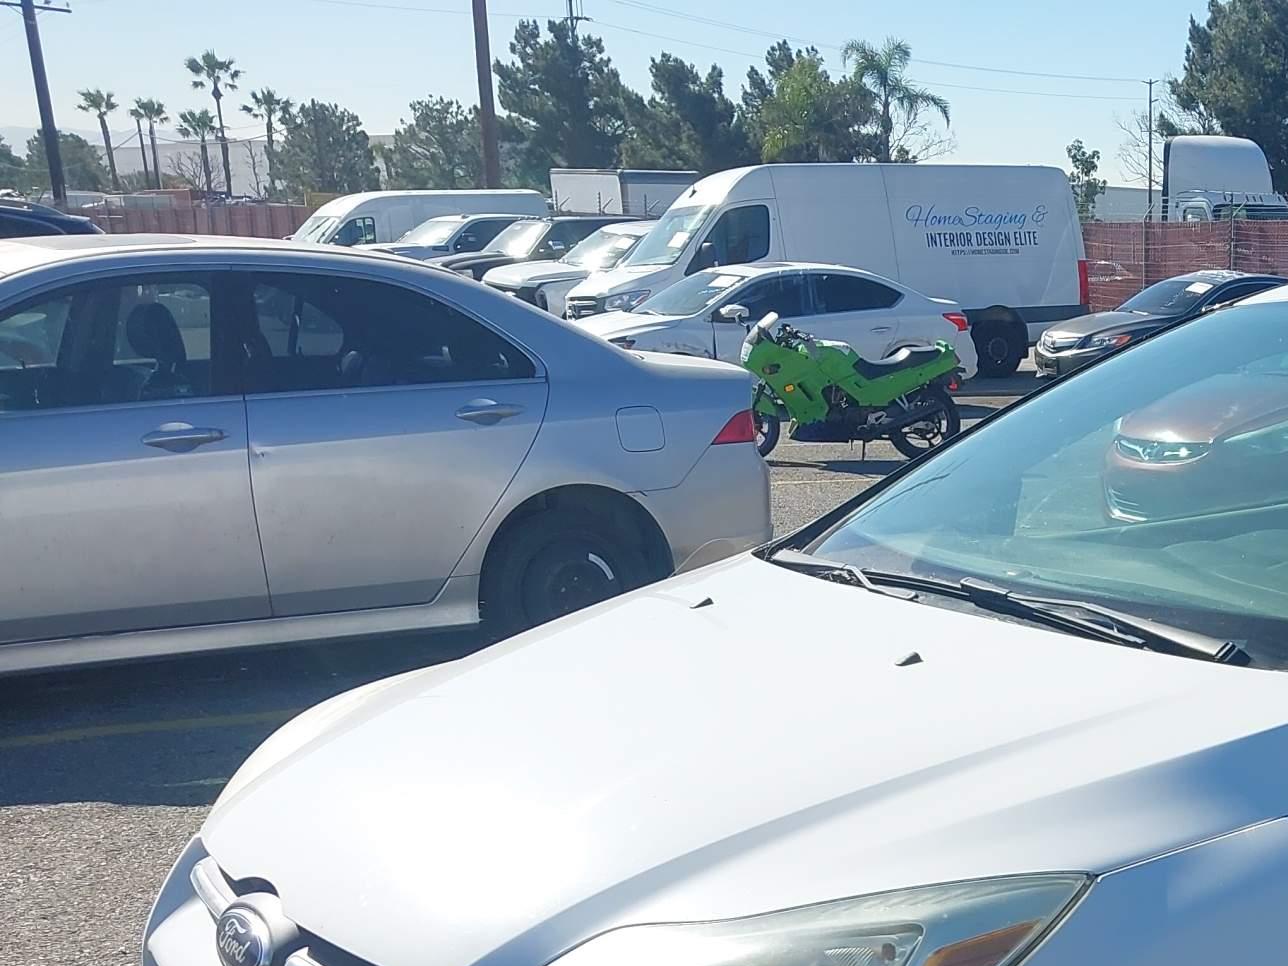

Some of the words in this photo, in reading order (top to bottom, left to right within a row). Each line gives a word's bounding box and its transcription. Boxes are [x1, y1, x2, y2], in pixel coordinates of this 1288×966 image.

[1031, 204, 1048, 224] &
[926, 232, 973, 248] INTERIOR
[975, 231, 1011, 247] DESIGN
[1013, 230, 1039, 246] ELITE
[220, 918, 251, 964] Ford
